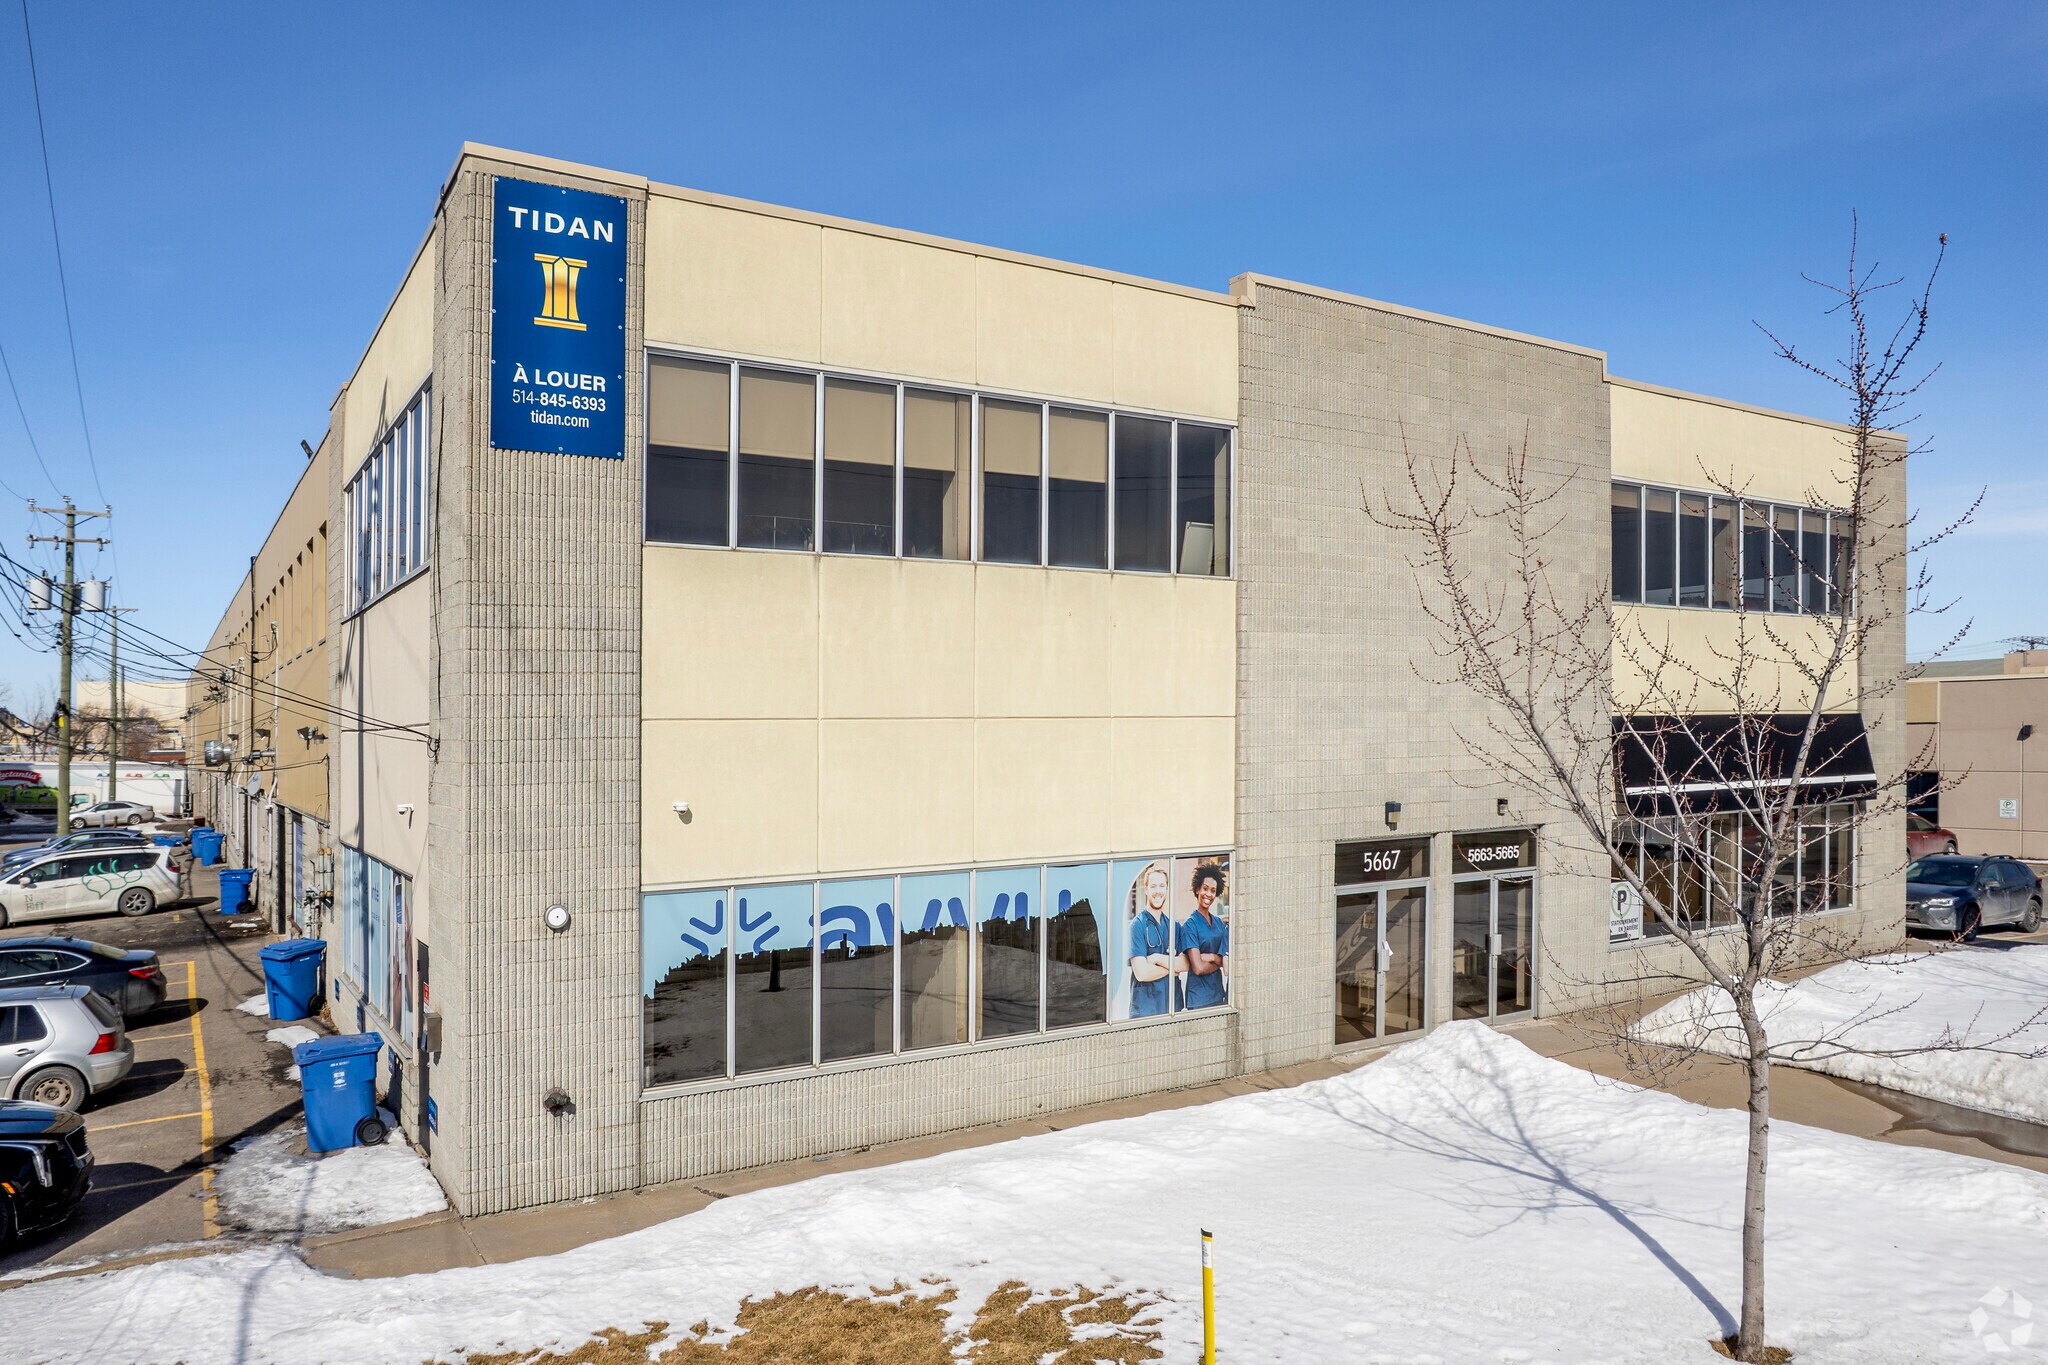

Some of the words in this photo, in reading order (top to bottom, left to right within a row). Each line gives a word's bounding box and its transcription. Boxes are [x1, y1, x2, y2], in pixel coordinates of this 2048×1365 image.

[508, 206, 614, 243] TIDAN
[512, 363, 529, 384] À
[535, 369, 606, 392] LOUER
[512, 389, 606, 411] 514-845-6393
[530, 410, 590, 428] tidan.com
[1363, 850, 1401, 873] 5667
[1467, 845, 1520, 863] 5663-5665
[1617, 890, 1627, 911] P
